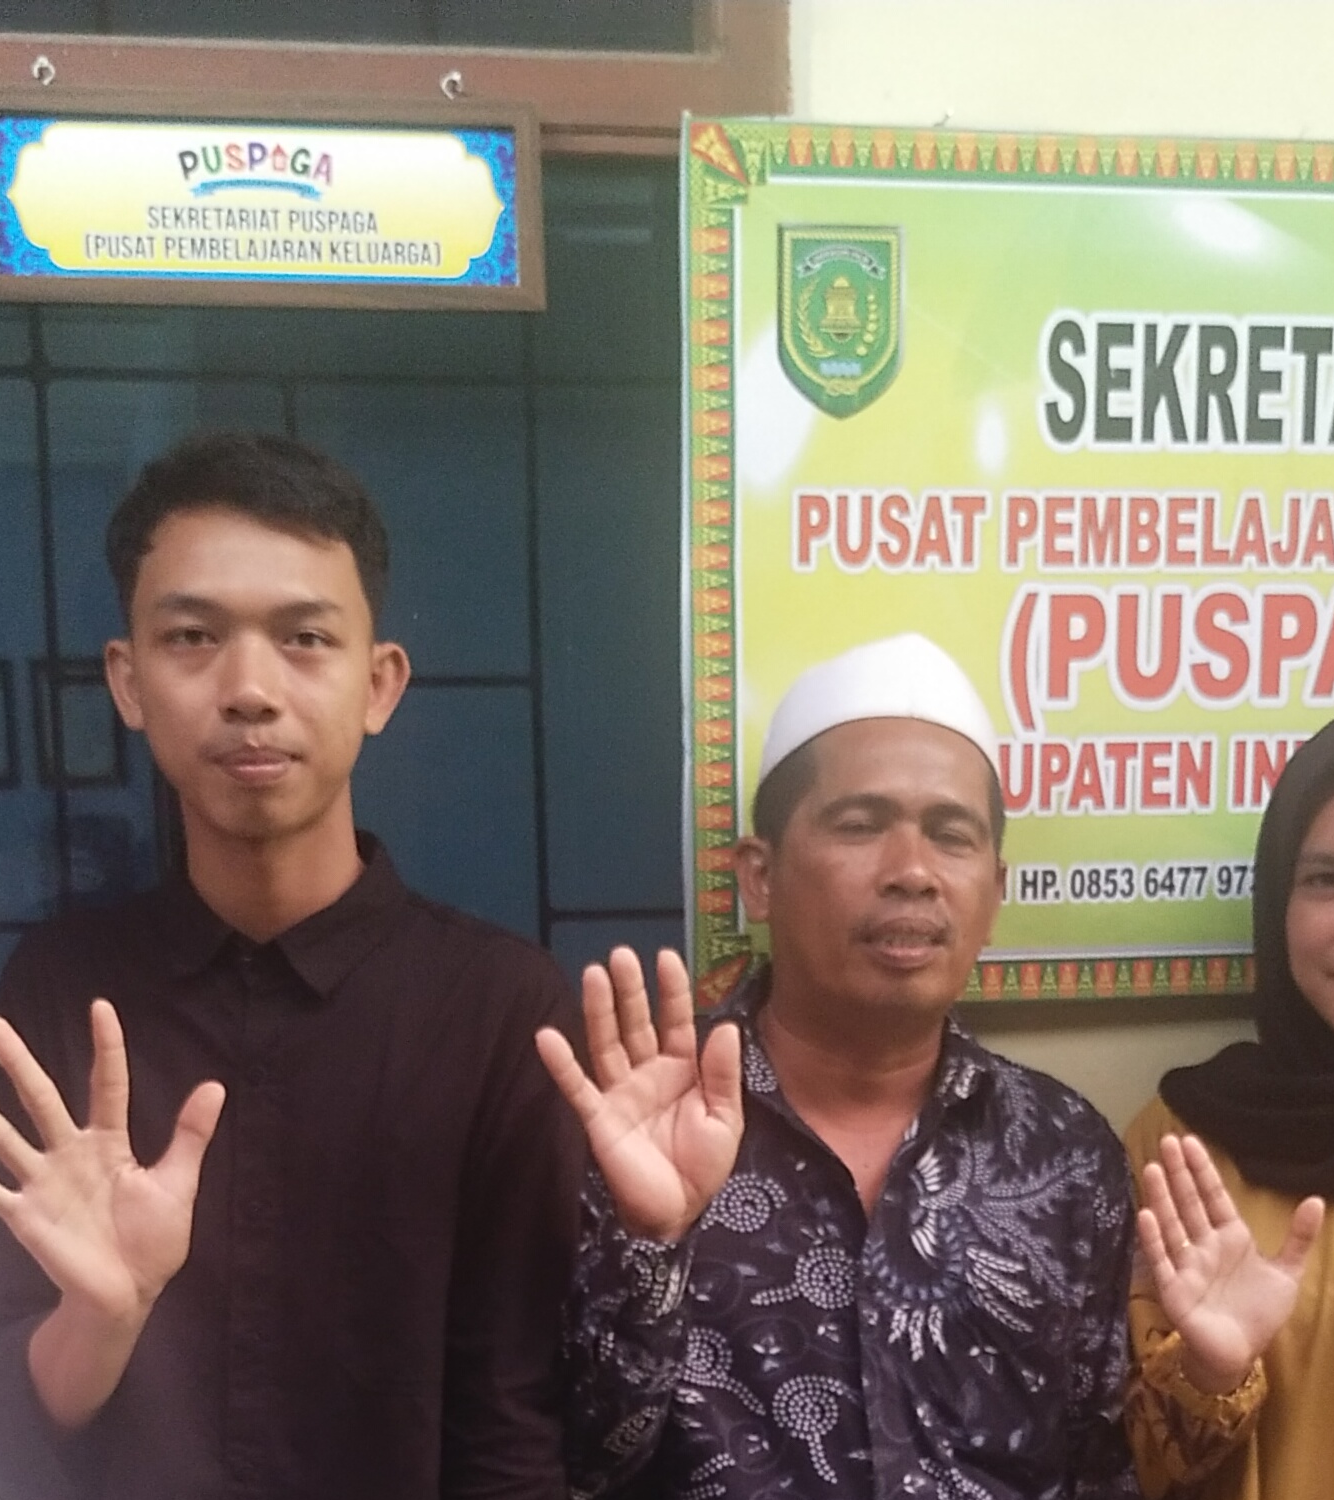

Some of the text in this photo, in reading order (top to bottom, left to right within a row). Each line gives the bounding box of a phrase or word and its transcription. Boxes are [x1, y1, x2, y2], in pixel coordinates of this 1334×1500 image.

[147, 206, 378, 234] SEKRETARIAT PUSPAGA
[84, 234, 442, 267] (PUSAT PEMBELAJARAN KELUARGA)
[796, 493, 987, 568] PUSAT
[998, 740, 1213, 811] UPATEN
[1020, 868, 1061, 900] HP.
[1070, 867, 1135, 898] 0853
[1144, 865, 1209, 897] 6477
[1217, 864, 1255, 896] 97
